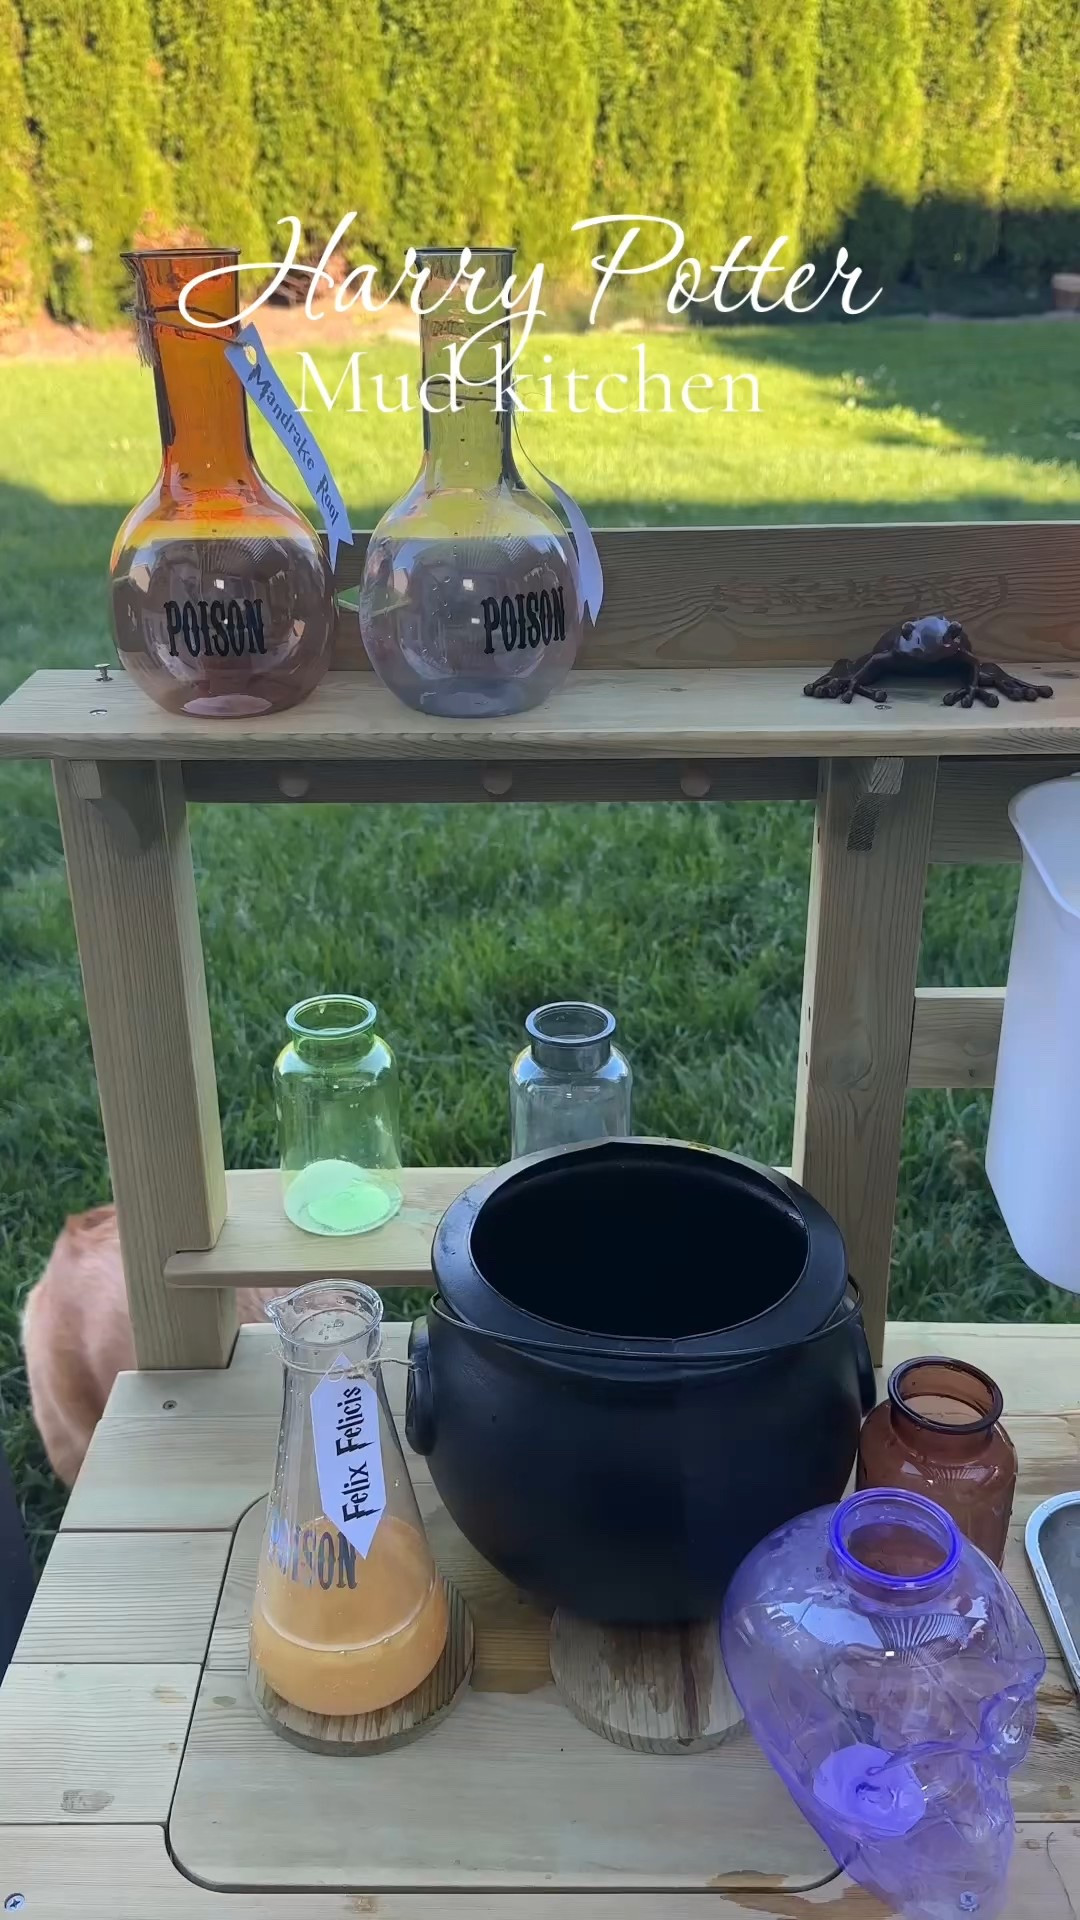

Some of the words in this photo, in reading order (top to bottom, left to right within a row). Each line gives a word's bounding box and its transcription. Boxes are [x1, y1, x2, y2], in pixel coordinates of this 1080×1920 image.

[248, 363, 315, 471] Mandrake
[163, 598, 268, 657] POISON
[480, 585, 566, 656] POISON
[336, 1386, 375, 1456] Felicis
[342, 1461, 381, 1523] Felix
